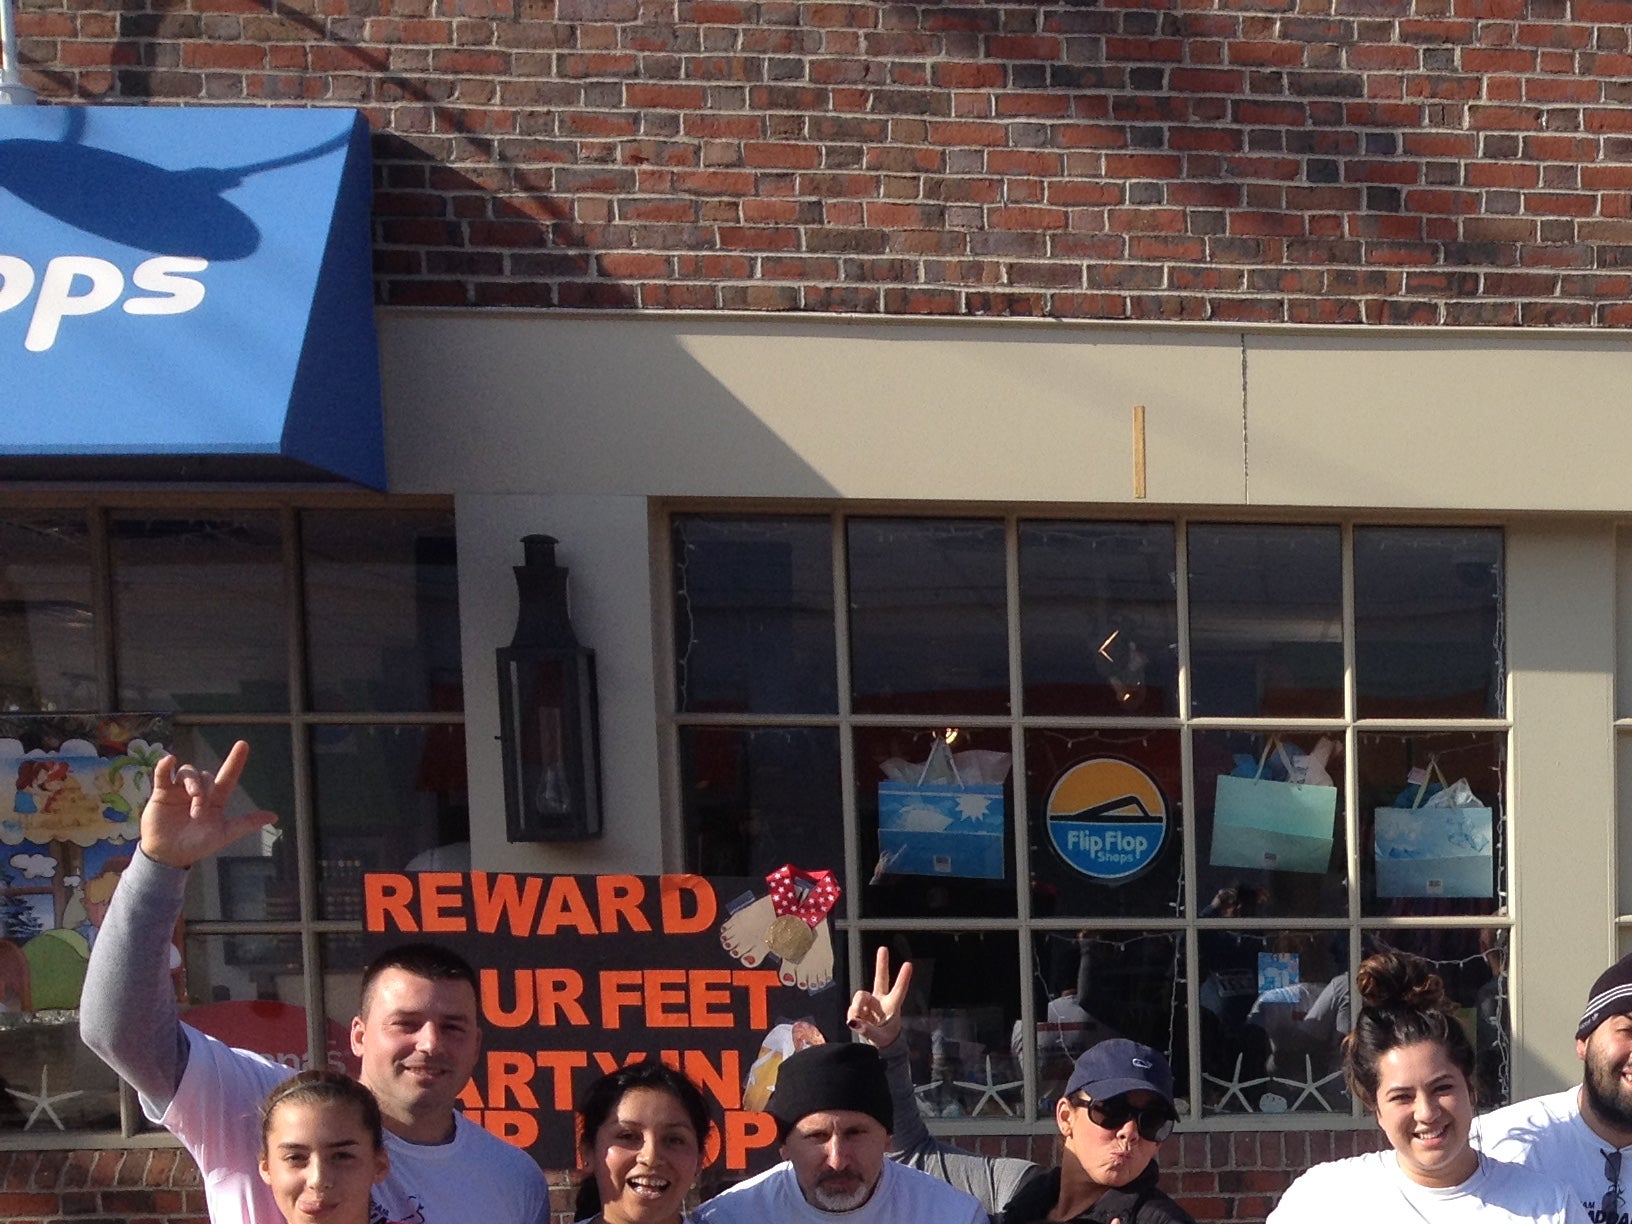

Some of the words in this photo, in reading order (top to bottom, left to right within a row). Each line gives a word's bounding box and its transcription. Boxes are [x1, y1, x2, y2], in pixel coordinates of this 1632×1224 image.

[1067, 830, 1103, 859] Flip
[1105, 831, 1148, 859] Flop
[1097, 851, 1134, 864] Shops
[363, 871, 717, 938] REWARD
[480, 968, 589, 1029] UR
[599, 969, 782, 1030] FEET
